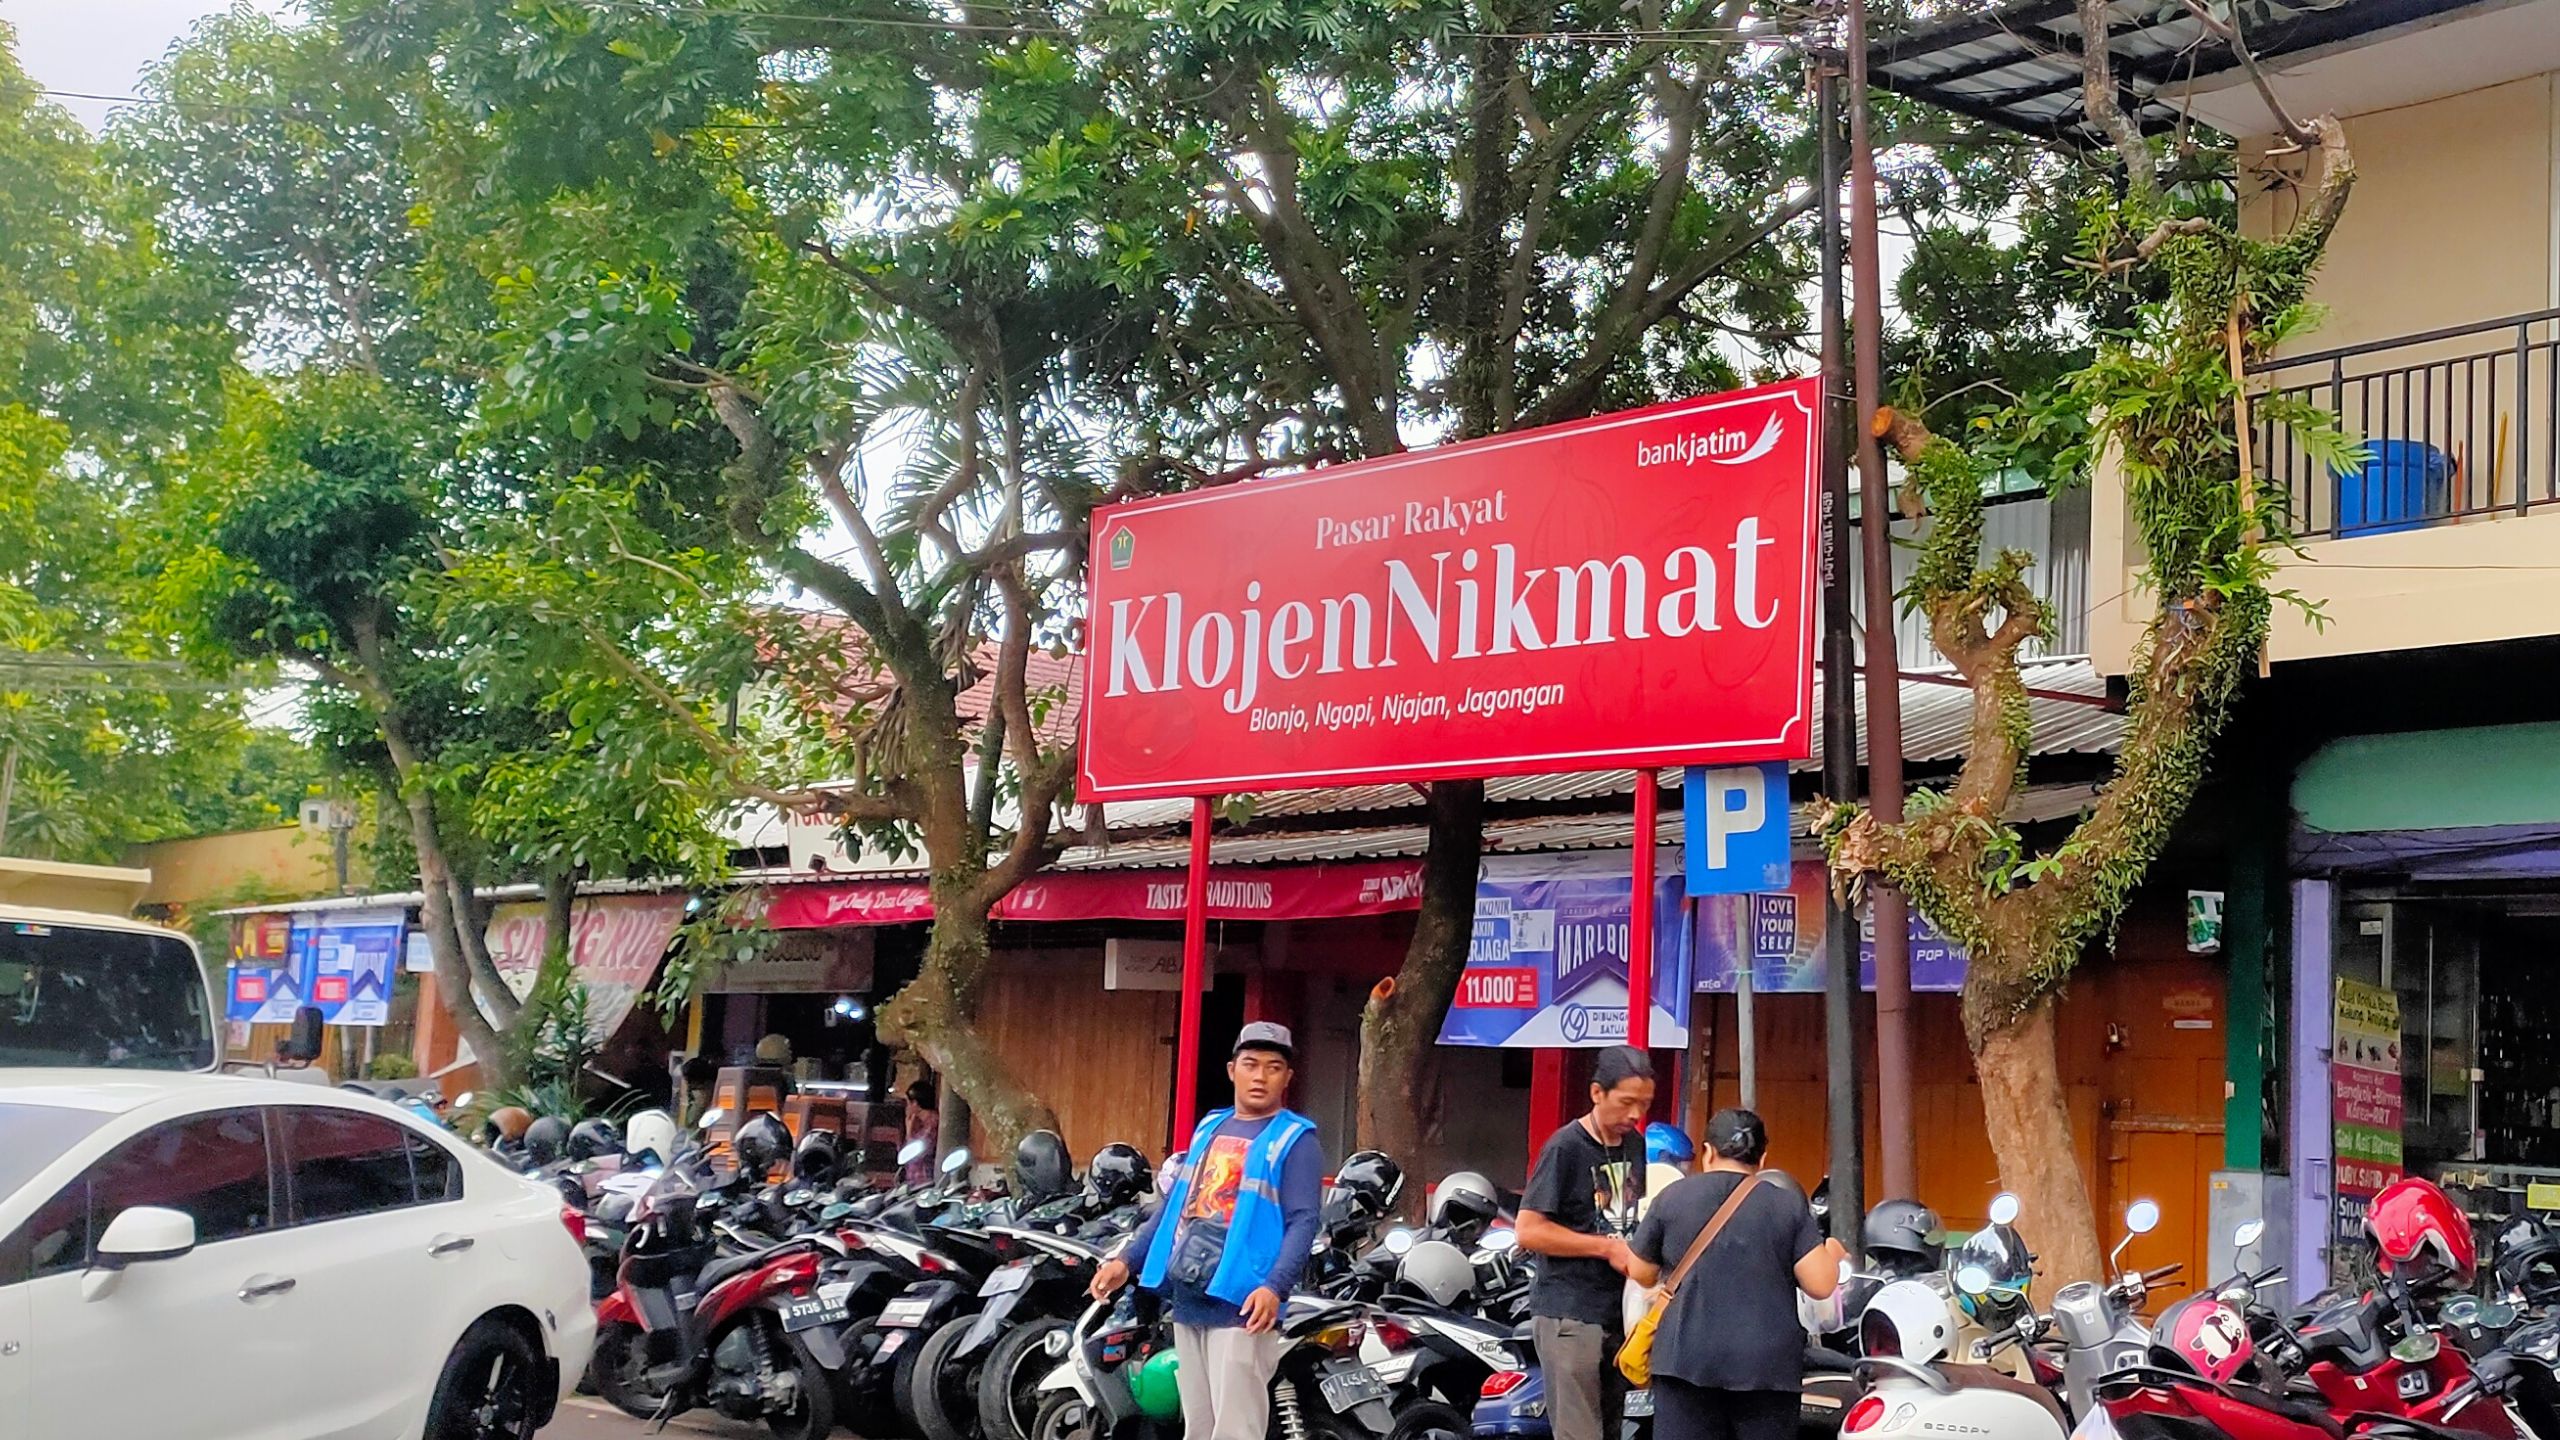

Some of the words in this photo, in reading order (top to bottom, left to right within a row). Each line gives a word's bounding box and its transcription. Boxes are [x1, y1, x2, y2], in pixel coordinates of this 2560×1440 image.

[1637, 428, 1747, 468] bankjatim
[1315, 513, 1396, 549] Pasar
[1404, 490, 1508, 536] Rakyat
[1249, 704, 1309, 735] Blonjo,
[1315, 696, 1376, 731] Ngopi,
[1382, 690, 1450, 725] Njajan,
[1458, 683, 1564, 717] Jagongan
[1706, 765, 1766, 870] P
[1146, 883, 1184, 909] TASTE
[1206, 880, 1272, 909] RADITIONS
[1762, 899, 1793, 914] LOVE
[1473, 921, 1495, 937] AKIN
[1760, 918, 1794, 932] YOUR
[1468, 939, 1511, 962] RJAGA
[1558, 923, 1655, 980] MARLBO
[1760, 935, 1793, 950] SELF
[1916, 950, 1944, 961] POP
[1592, 1012, 1628, 1022] DIBUNG
[1600, 1025, 1628, 1035] SATUA
